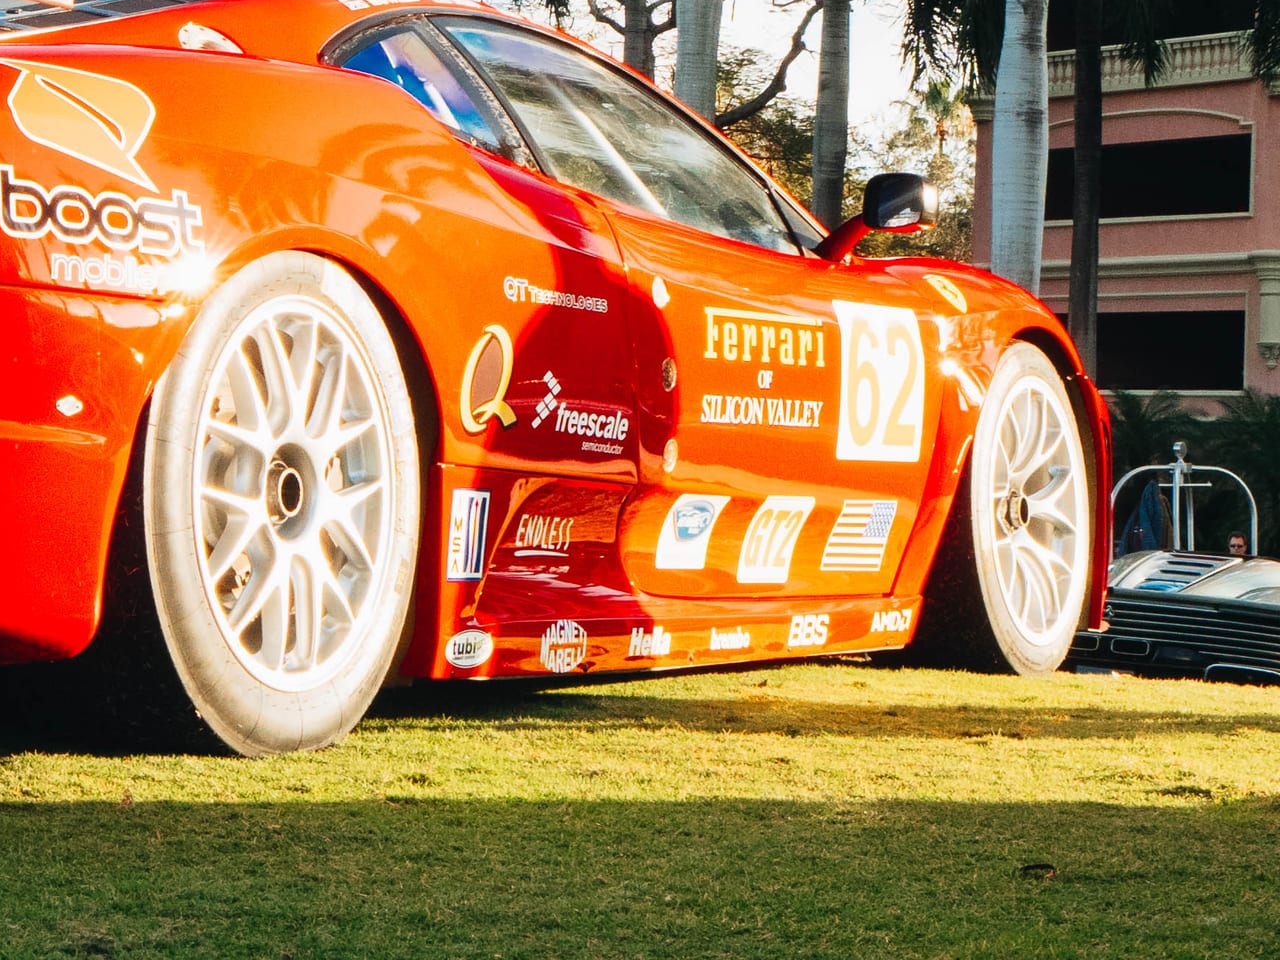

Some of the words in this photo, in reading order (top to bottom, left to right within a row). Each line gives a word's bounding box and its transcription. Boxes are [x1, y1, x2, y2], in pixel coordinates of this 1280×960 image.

[704, 307, 825, 368] Ferrari
[757, 370, 773, 389] OF
[847, 317, 917, 446] 62
[555, 402, 629, 440] freescale
[701, 394, 764, 426] SILICON
[766, 399, 823, 427] VALLEY
[515, 514, 575, 551] ENDLESS
[744, 509, 804, 568] GT2
[541, 619, 587, 645] MAGNETI
[788, 614, 829, 647] BBS
[870, 611, 901, 632] AMD
[453, 637, 477, 655] tubi
